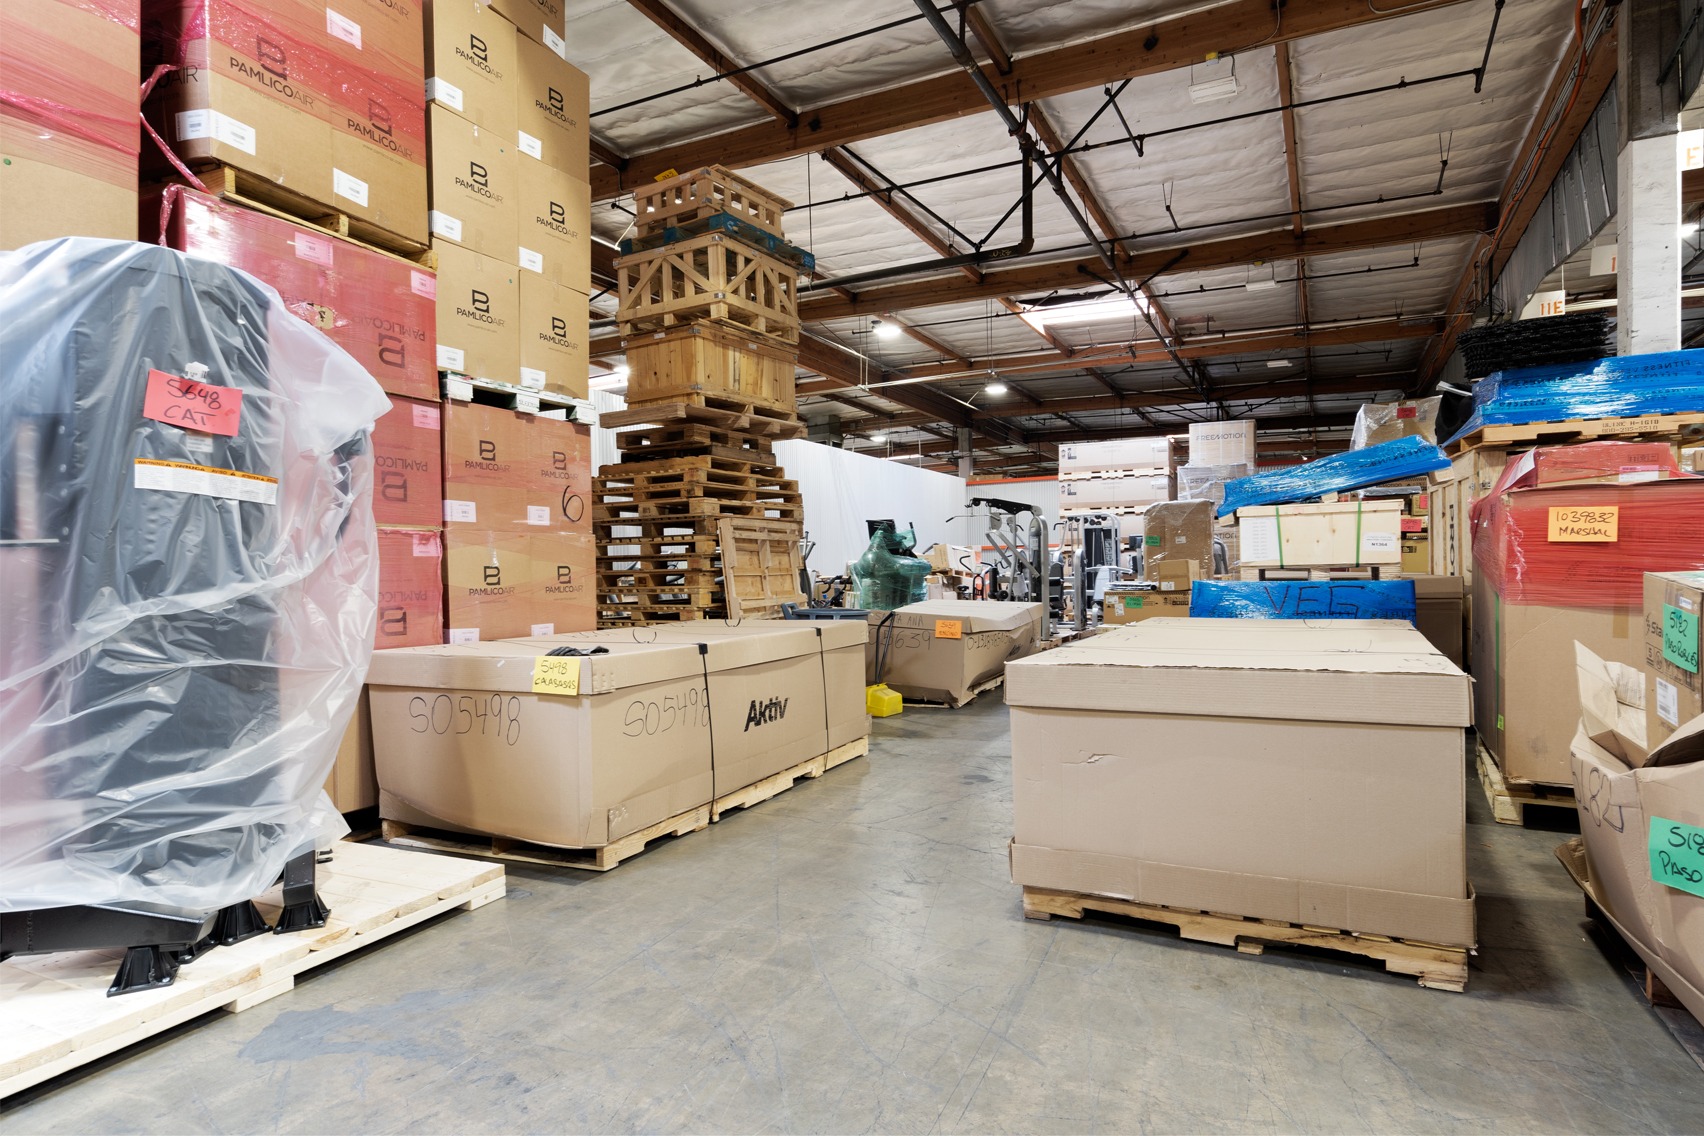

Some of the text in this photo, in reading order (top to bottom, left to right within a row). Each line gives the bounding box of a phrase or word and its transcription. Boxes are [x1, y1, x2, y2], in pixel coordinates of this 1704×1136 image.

[455, 46, 504, 82] PAMLICOAIR
[229, 55, 315, 110] PAMLICOAIR
[535, 99, 577, 129] PAMLICOAIR
[347, 118, 413, 161] PAMLICOAIR
[455, 177, 504, 205] PAMLICOAIR
[536, 216, 579, 239] PAMLICOAIR
[456, 307, 506, 328] PAMLICOAIR
[539, 332, 579, 351] PAMLICOAIR
[166, 378, 222, 410] 5648
[163, 404, 217, 426] CAT
[464, 460, 511, 473] PAMLICOAIR
[540, 469, 579, 481] PAMLICOAIR
[562, 485, 585, 523] 6
[1556, 510, 1615, 524] 1039832
[540, 659, 568, 675] 5498
[744, 696, 789, 733] Aktiv
[1658, 850, 1703, 884] PASO
